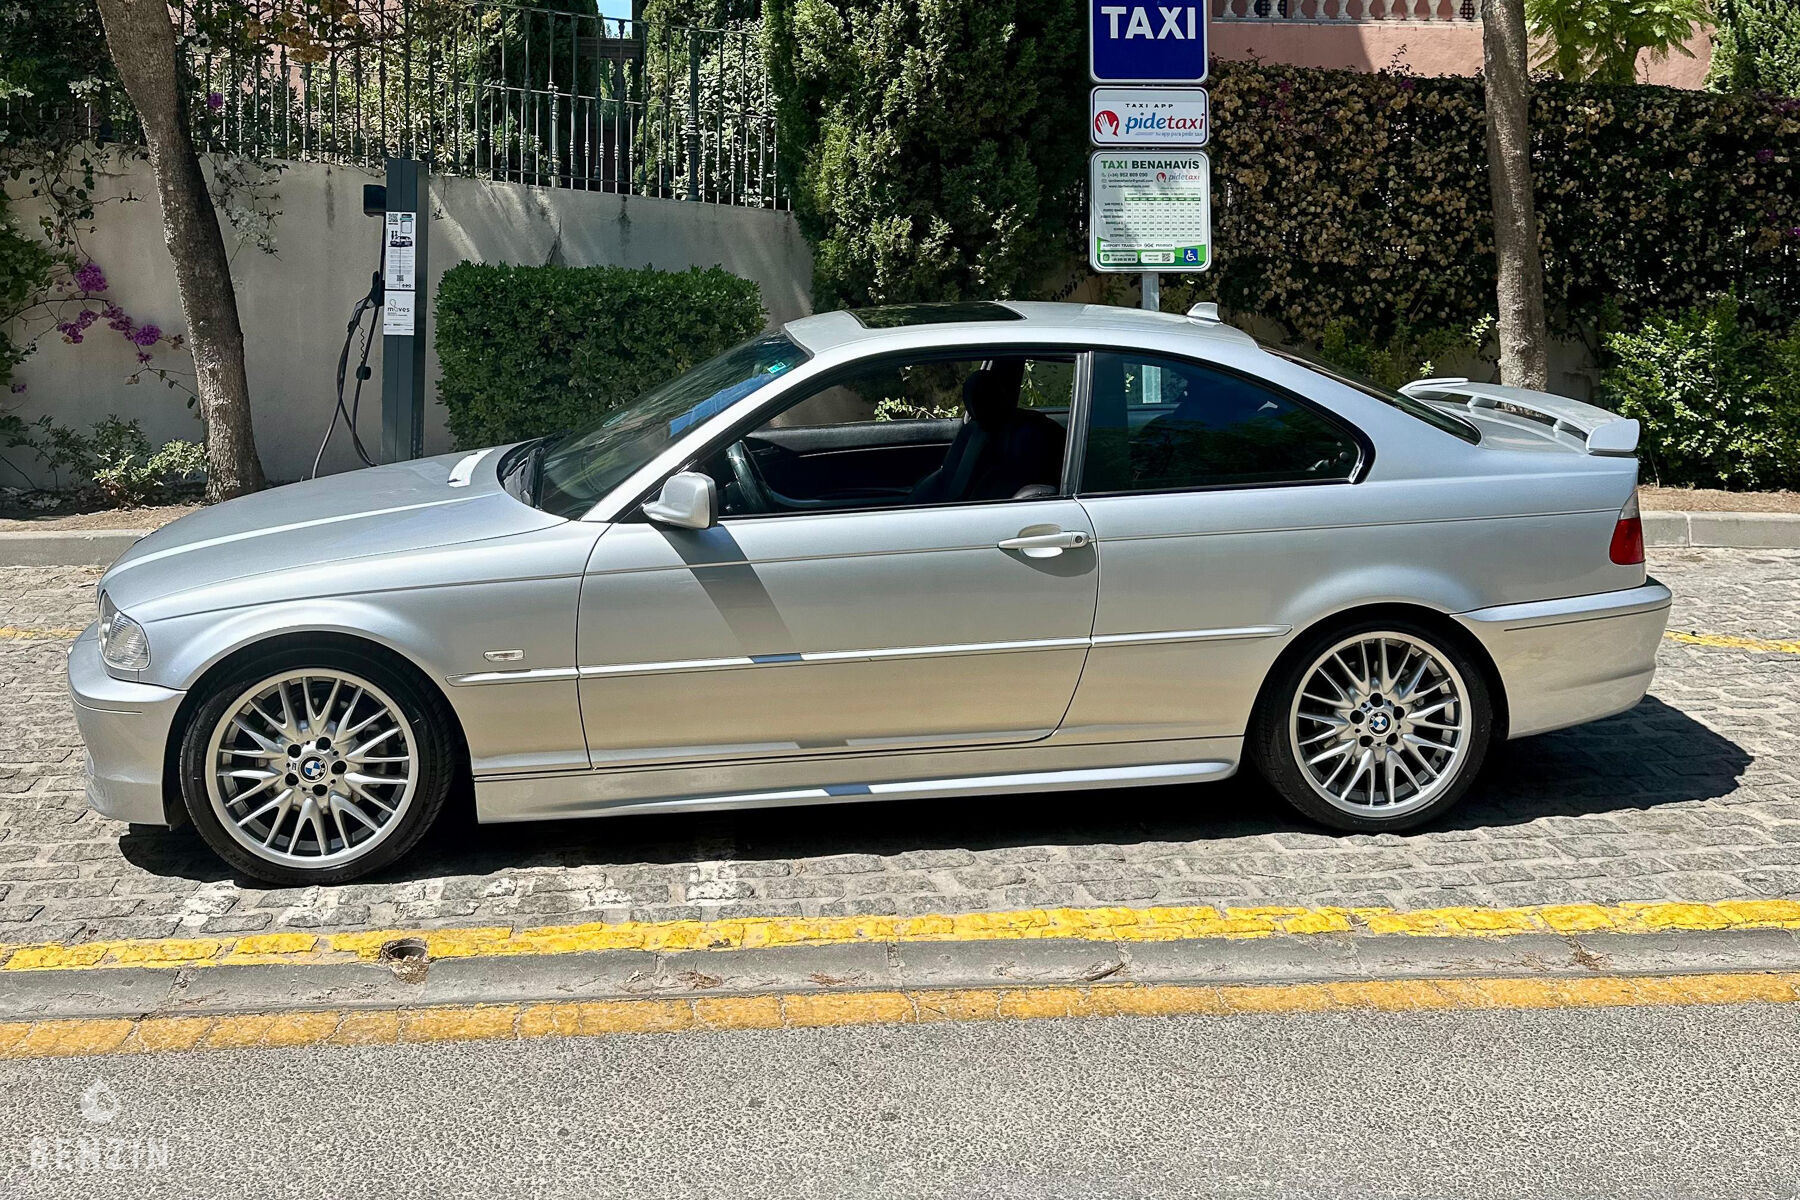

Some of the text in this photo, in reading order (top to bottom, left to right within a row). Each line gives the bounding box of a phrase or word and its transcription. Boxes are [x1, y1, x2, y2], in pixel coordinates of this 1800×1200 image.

[1101, 6, 1196, 40] TAXI
[1125, 112, 1205, 134] pidetaxi
[1101, 158, 1200, 170] TAXI BENAHAVÍS
[1168, 172, 1200, 182] pidetaxi
